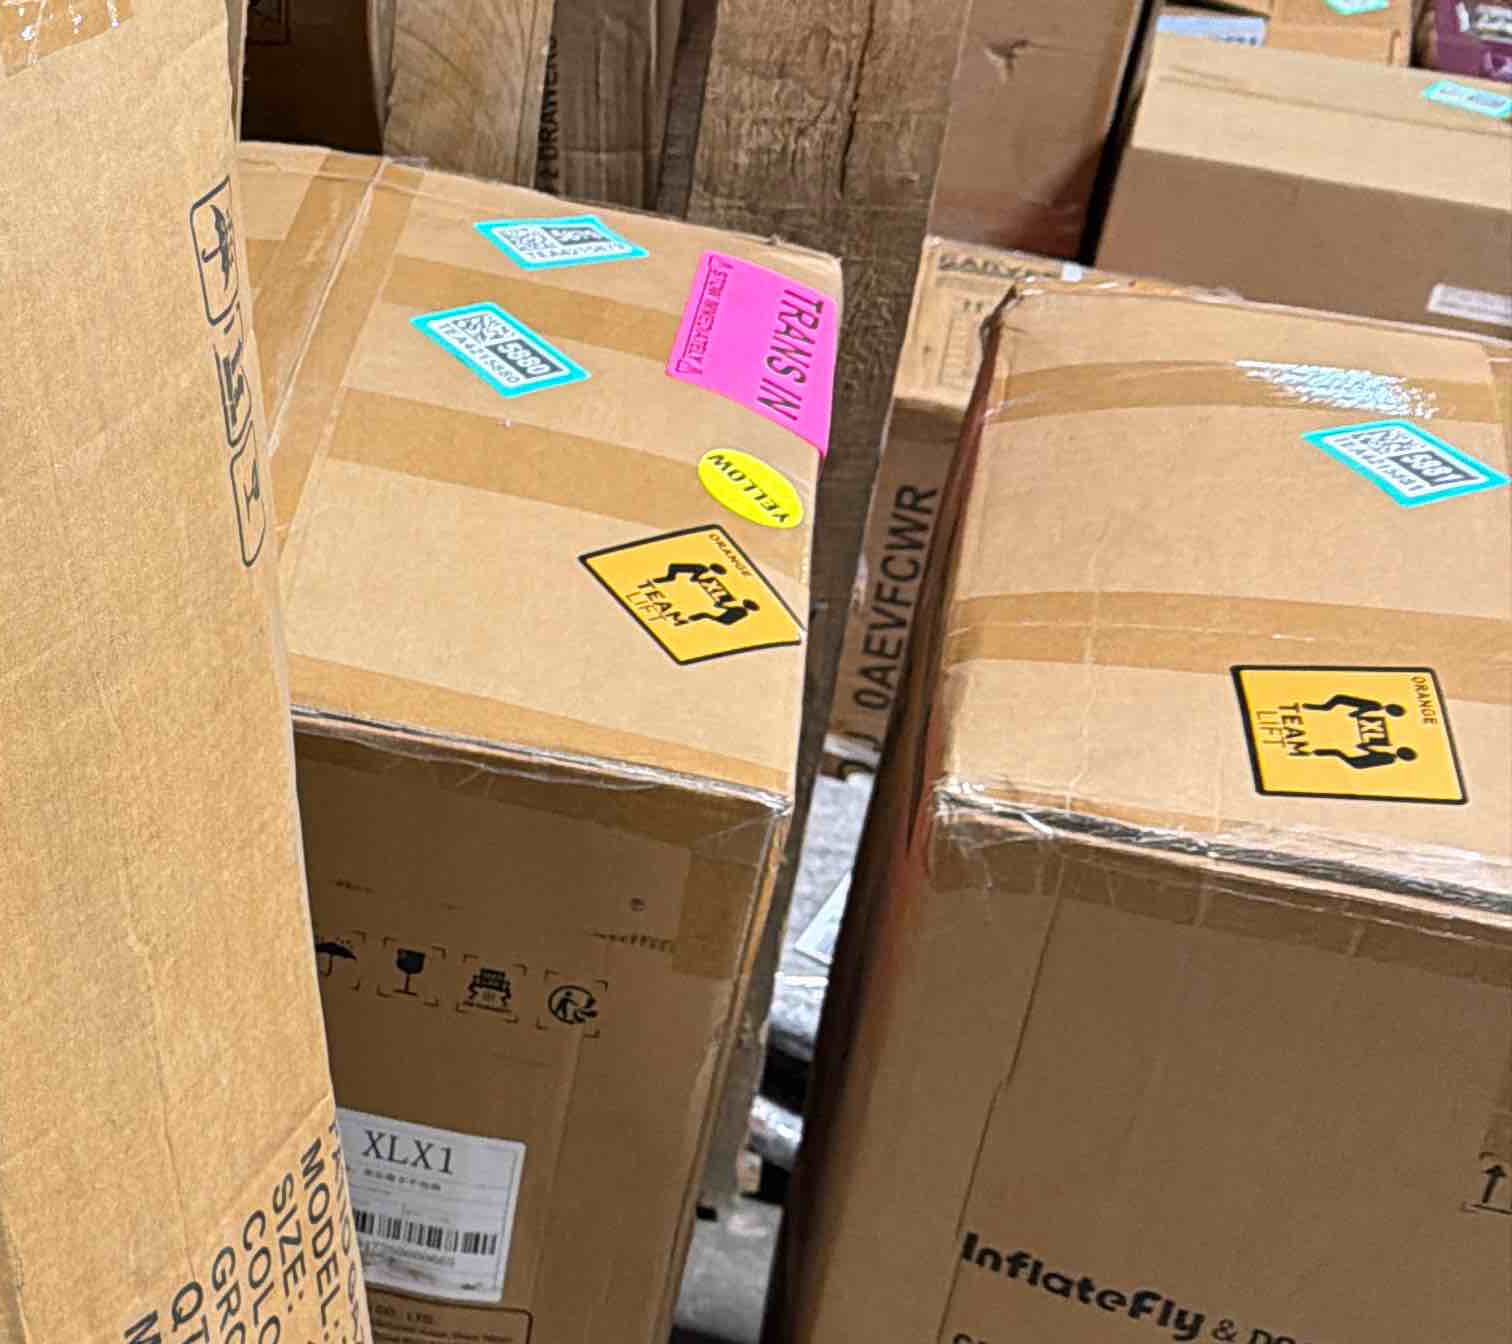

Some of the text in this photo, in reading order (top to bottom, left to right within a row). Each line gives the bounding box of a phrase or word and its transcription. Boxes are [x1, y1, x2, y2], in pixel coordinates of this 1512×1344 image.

[497, 343, 554, 375] 5880
[758, 290, 824, 421] TRANS IN
[708, 454, 790, 524] YELLOW
[1400, 453, 1464, 483] 5881
[709, 533, 753, 578] ORANGE
[626, 592, 668, 623] LIFT
[637, 579, 689, 627] TEAM
[1411, 676, 1437, 725] ORANGE
[1256, 710, 1286, 748] LIFT
[1278, 702, 1310, 757] TEAM
[362, 1130, 455, 1175] XLX1
[272, 1172, 306, 1313] SIZE:
[300, 1137, 339, 1342] MODEL:
[1211, 1318, 1238, 1343] &
